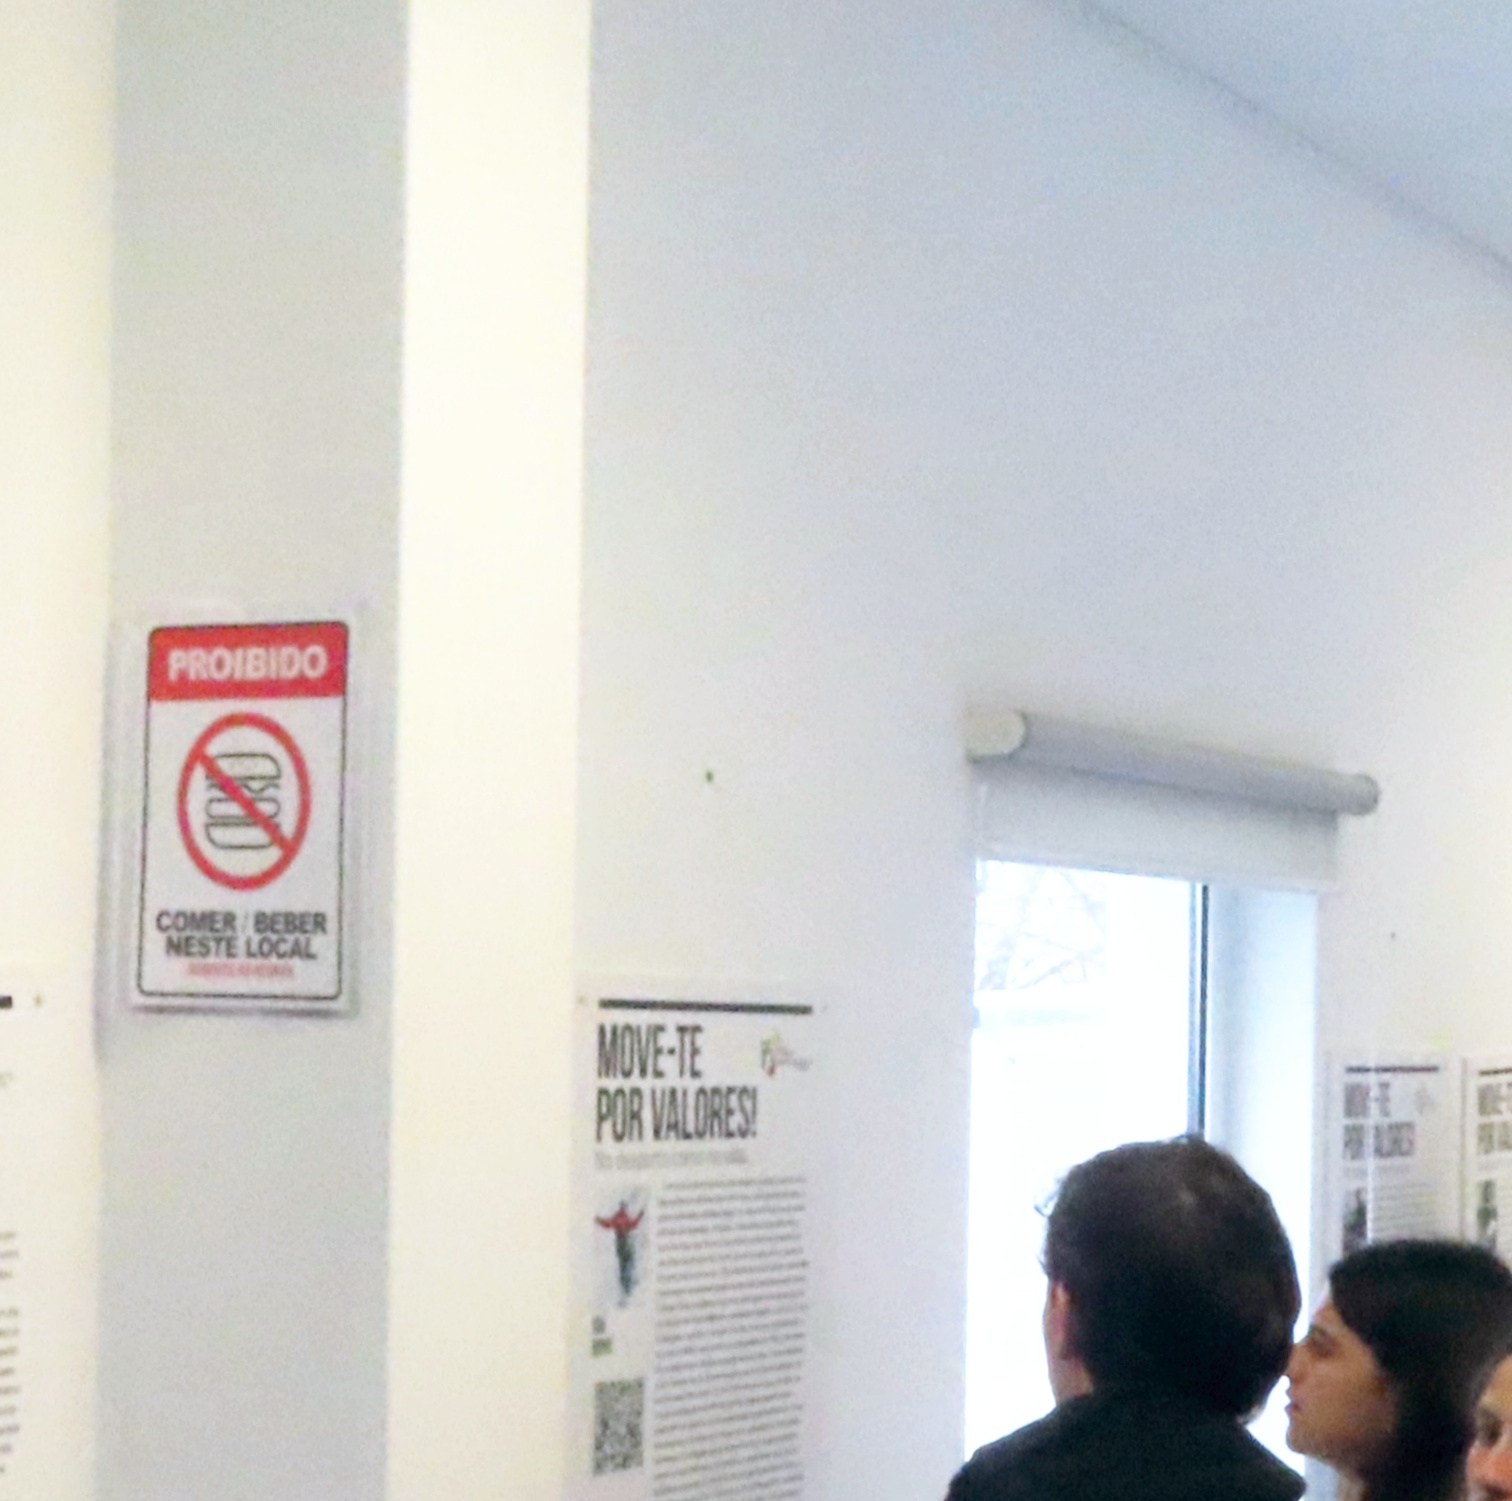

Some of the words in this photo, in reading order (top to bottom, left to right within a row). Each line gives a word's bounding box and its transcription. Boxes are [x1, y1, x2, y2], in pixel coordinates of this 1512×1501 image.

[168, 645, 327, 681] PROIBIDO
[156, 911, 236, 933] COMER
[254, 911, 327, 934] BEBER
[166, 936, 237, 958] NESTE
[245, 936, 317, 959] LOCAL
[597, 1023, 703, 1079] MOVE-TE
[596, 1087, 642, 1142] POR
[650, 1085, 757, 1141] VALORES!
